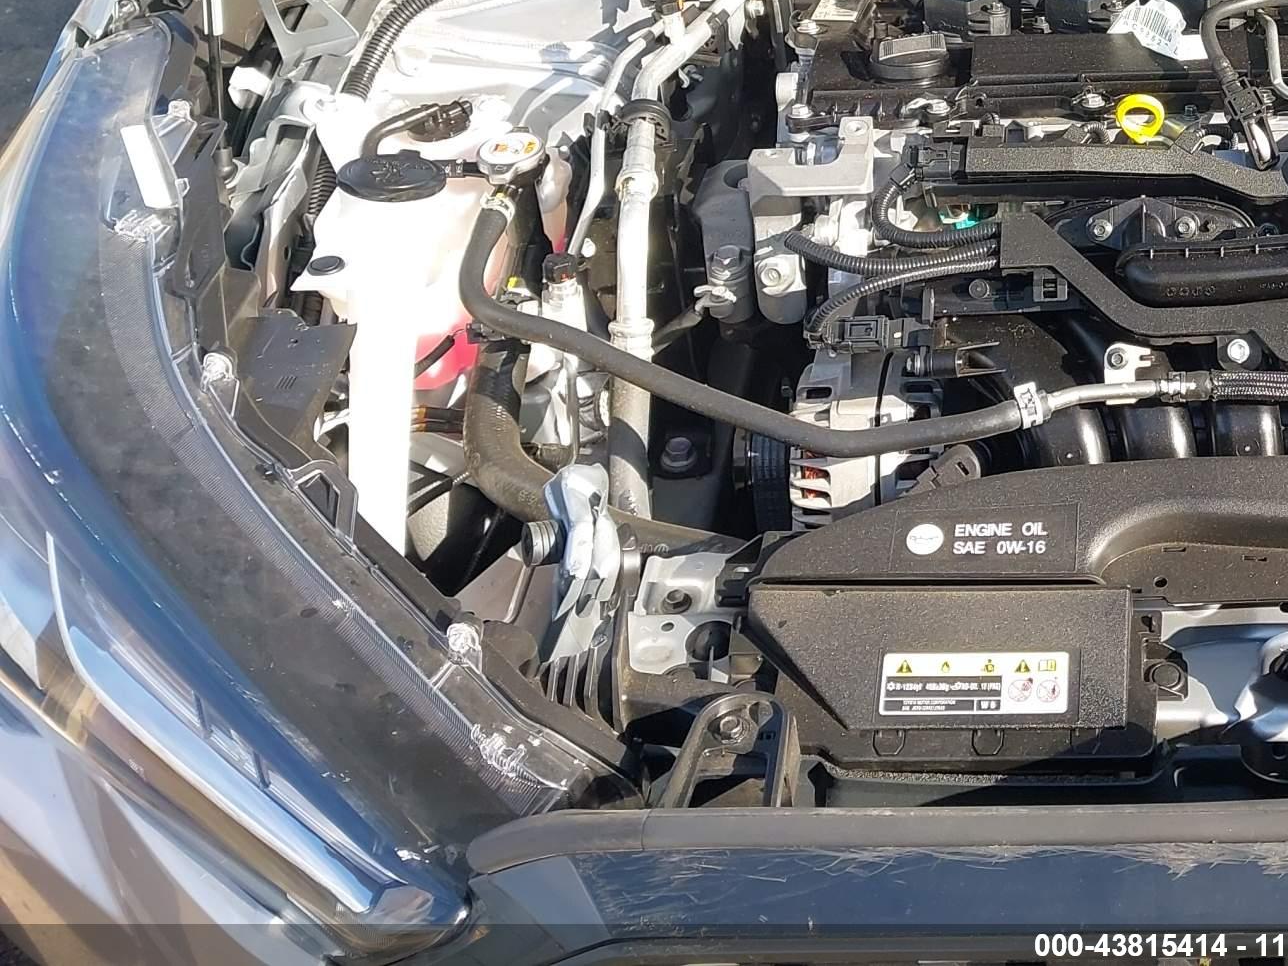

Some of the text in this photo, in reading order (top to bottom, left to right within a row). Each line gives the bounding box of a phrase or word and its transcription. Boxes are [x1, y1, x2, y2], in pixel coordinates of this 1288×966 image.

[954, 522, 1049, 537] ENGINE OIL
[952, 539, 1047, 555] SAE 0W-16
